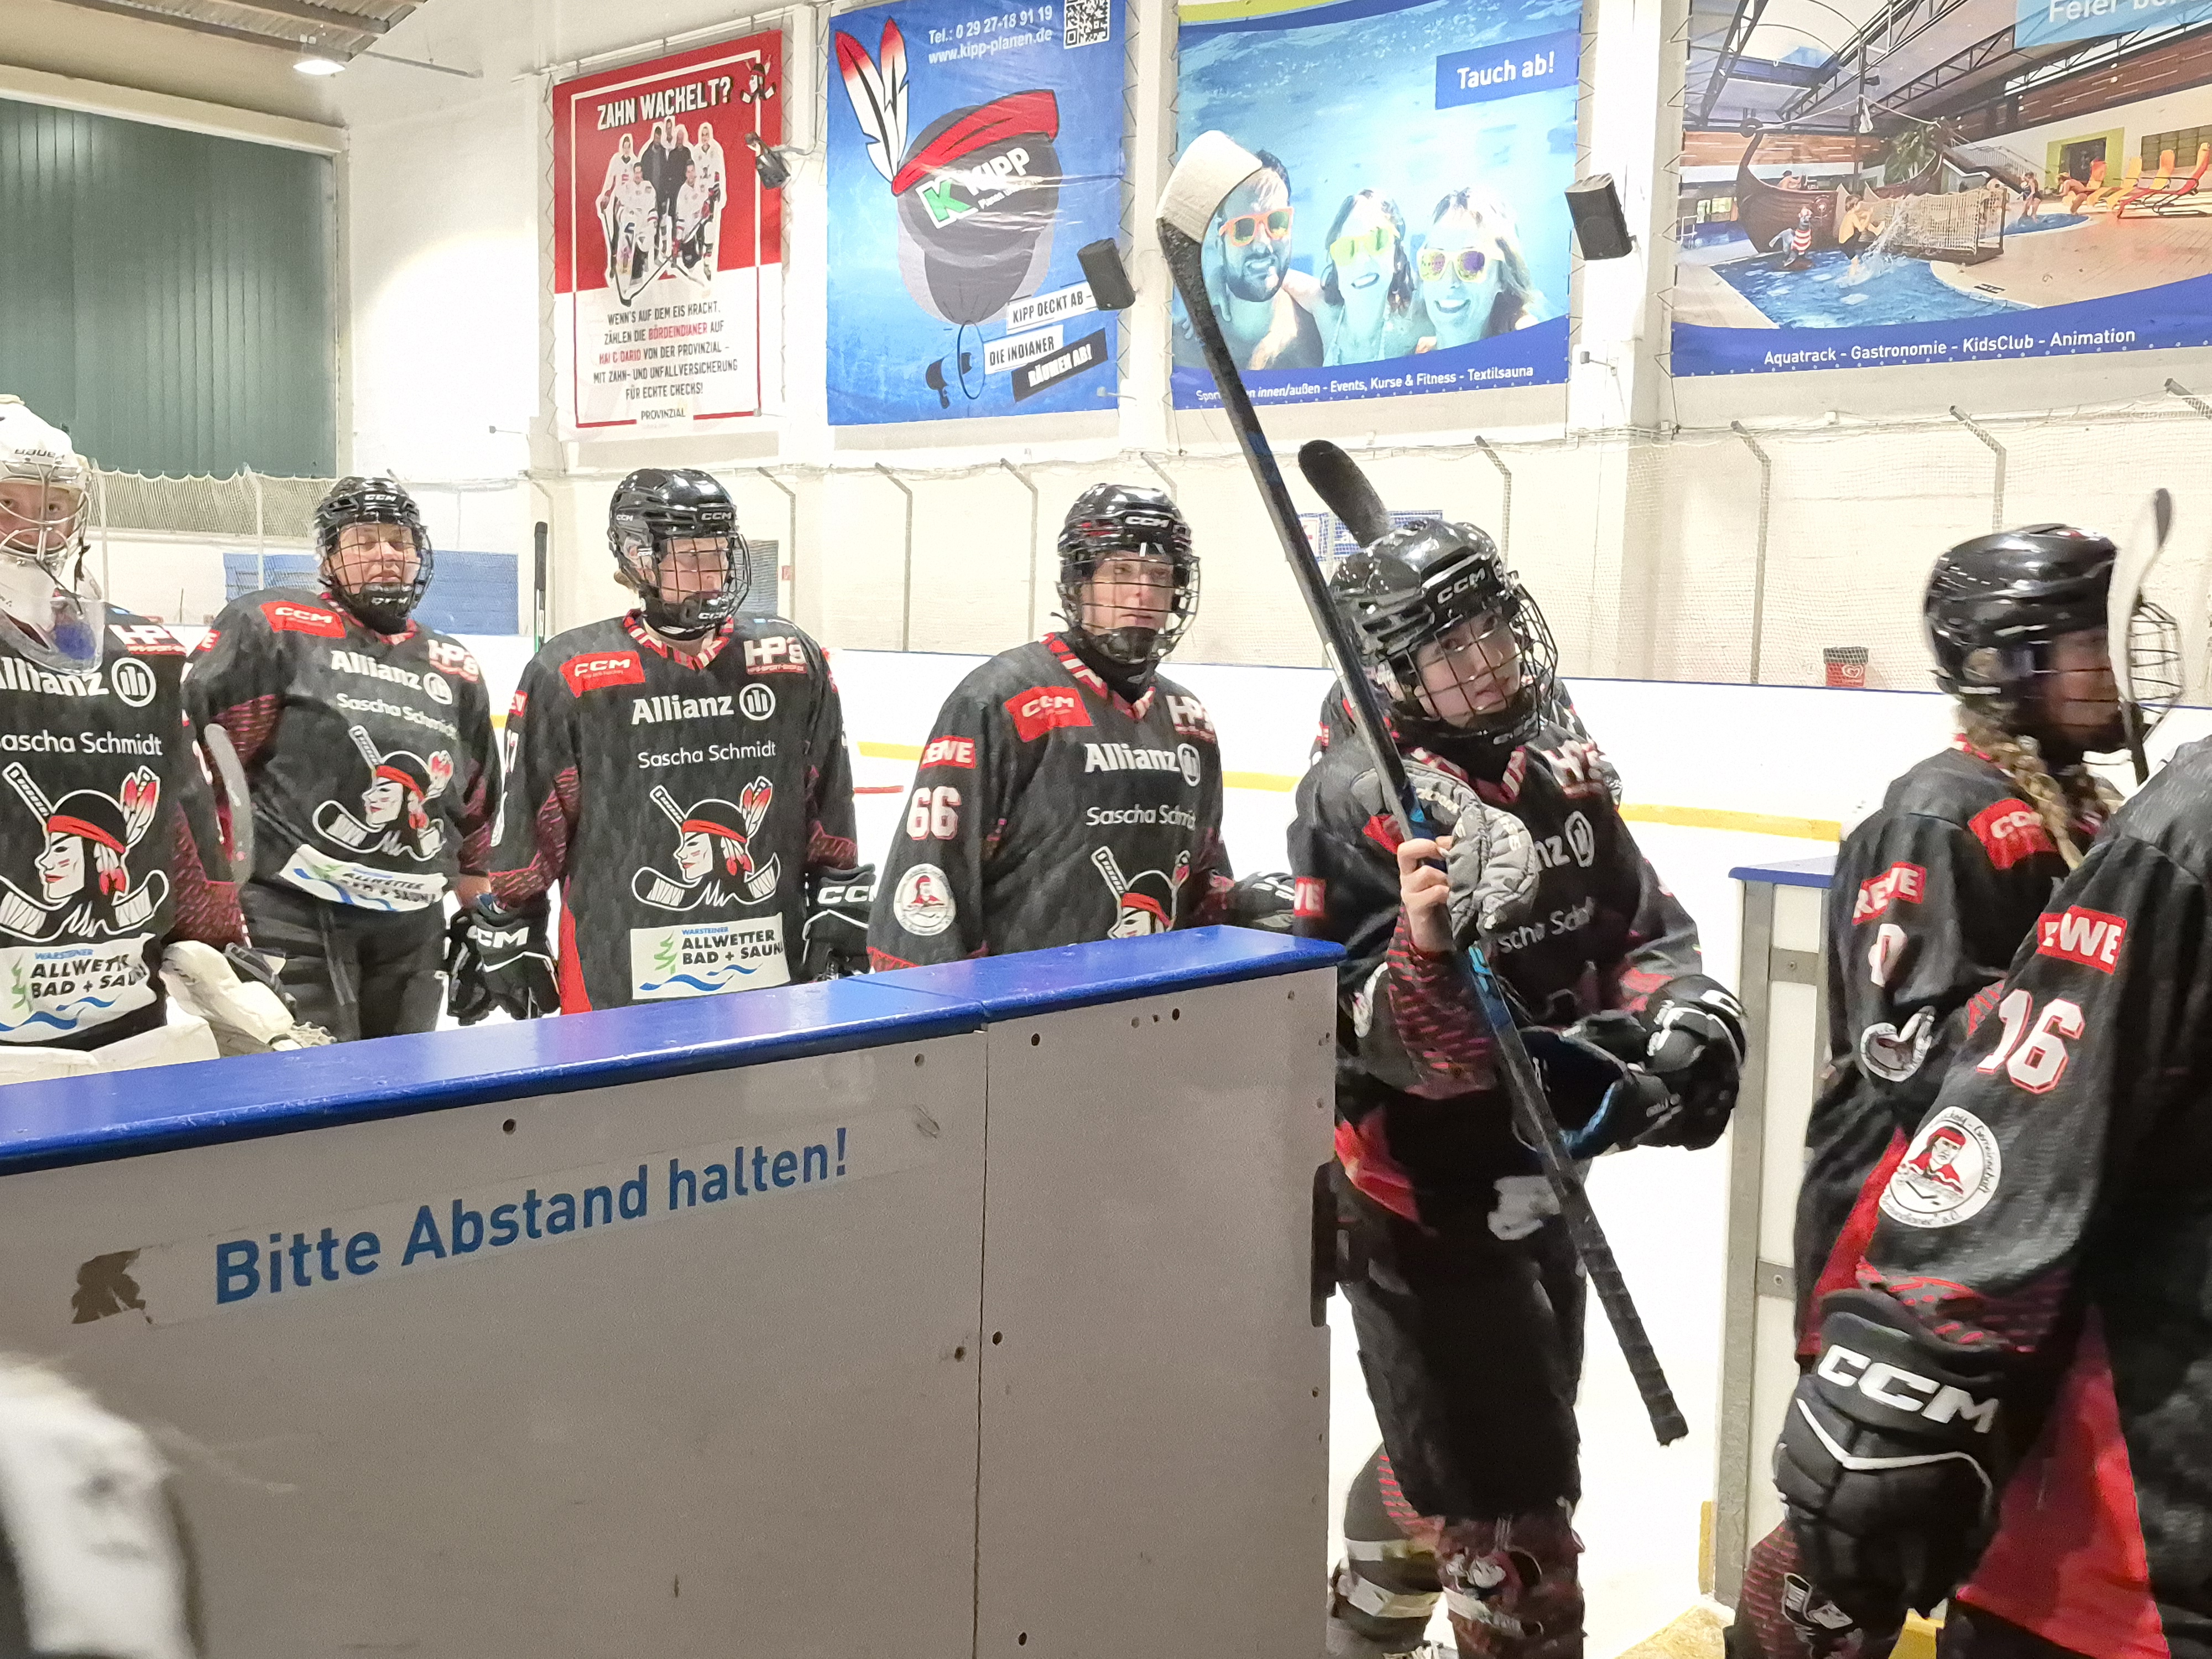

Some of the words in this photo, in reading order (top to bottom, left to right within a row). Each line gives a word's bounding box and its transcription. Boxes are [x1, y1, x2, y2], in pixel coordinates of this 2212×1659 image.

[928, 28, 953, 44] Tel.:
[956, 24, 963, 39] 0
[966, 20, 980, 37] 29
[984, 13, 1016, 34] 27-18
[1020, 8, 1034, 26] 91
[1038, 5, 1052, 22] 19
[928, 27, 1052, 64] www.kipp-planen.de
[1457, 59, 1516, 90] Tauch
[1522, 51, 1555, 78] ab!
[597, 98, 638, 131] ZAHN
[640, 76, 733, 121] WACKELT?
[608, 311, 636, 326] WENN'S
[638, 309, 652, 322] AUF
[654, 307, 670, 320] DEM
[673, 305, 685, 319] EIS
[1013, 305, 1034, 323] KIPP
[1037, 295, 1067, 316] DECKT
[1071, 291, 1083, 307] AB
[604, 330, 632, 346] ZÄHLEN
[634, 329, 646, 342] DIE
[711, 320, 724, 333] AUF
[1764, 347, 1836, 367] Aquatrack
[1850, 340, 1947, 360] Gastronomie
[1963, 334, 2034, 353] KidsClub
[2049, 328, 2136, 348] Animation
[644, 346, 658, 359] VON
[660, 345, 675, 358] DER
[678, 341, 722, 357] PROVINZIAL
[989, 349, 1004, 367] DIE
[1008, 336, 1055, 362] INDIANER
[593, 372, 606, 384] MIT
[609, 370, 630, 383] ZAHN-
[633, 368, 648, 380] UND
[650, 359, 738, 379] UNFALLVERSICHERUNG
[1027, 353, 1073, 388] RÄUMEN
[1072, 343, 1093, 367] AB!
[625, 385, 640, 400] FÜR
[643, 385, 667, 398] ECHTE
[1258, 383, 1320, 398] innen/außen
[1330, 380, 1368, 393] Events,
[1370, 375, 1402, 389] Kurse
[1405, 374, 1414, 386] &
[1416, 370, 1457, 385] Fitness
[1467, 366, 1533, 382] Textilsauna
[641, 408, 686, 420] PROVINZIAL
[701, 512, 732, 521] CCM
[1125, 516, 1170, 527] CCM
[1438, 567, 1486, 605] CCM
[275, 607, 332, 624] CCM
[331, 650, 422, 691] Allianz
[336, 693, 401, 717] Sascha
[631, 695, 734, 726] Allianz
[1021, 695, 1076, 718] CCM
[80, 731, 163, 756] Schmidt
[638, 747, 704, 769] Sascha
[708, 740, 776, 761] Schmidt
[1084, 742, 1181, 773] Allianz
[906, 785, 961, 841] 66
[1086, 804, 1156, 826] Sascha
[1991, 810, 2043, 839] CC
[681, 930, 775, 950] ALLWETTER
[683, 951, 719, 965] BAD
[724, 951, 734, 961] +
[31, 981, 76, 999] BAD
[83, 980, 93, 993] +
[1976, 988, 2085, 1094] 16
[215, 1227, 382, 1306] Bitte
[400, 1164, 649, 1265] Abstand
[669, 1127, 847, 1211] halten!
[1817, 1344, 2000, 1434] CCM
